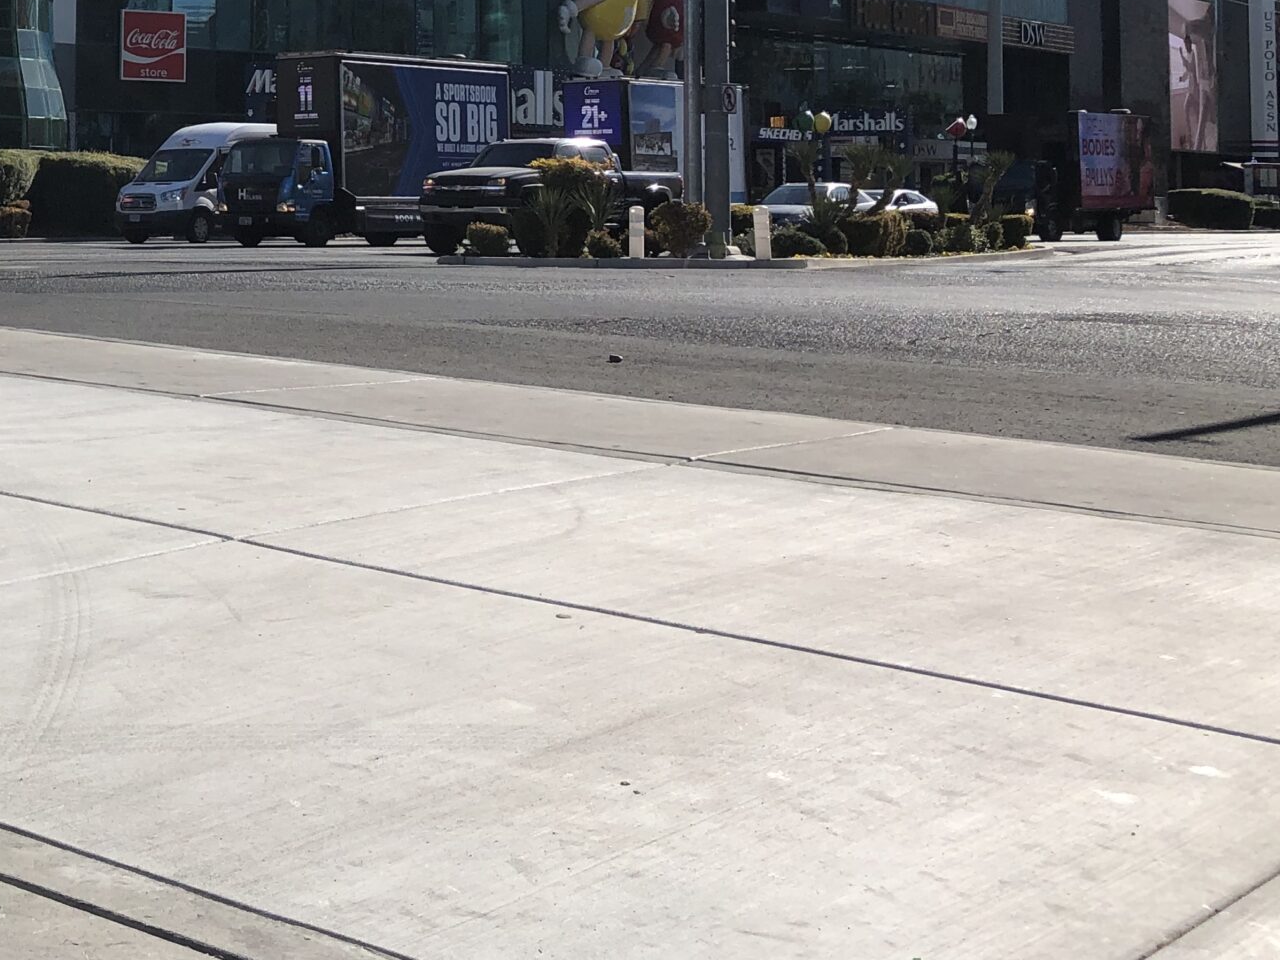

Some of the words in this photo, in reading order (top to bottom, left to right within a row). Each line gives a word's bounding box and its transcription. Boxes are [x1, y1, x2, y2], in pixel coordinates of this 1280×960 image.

[1020, 22, 1047, 46] DSW
[140, 68, 168, 77] store
[435, 82, 442, 101] A
[443, 83, 497, 103] SPORTSBOOK
[435, 101, 461, 142] SO
[466, 103, 498, 143] BIG
[1082, 138, 1116, 156] BODIES
